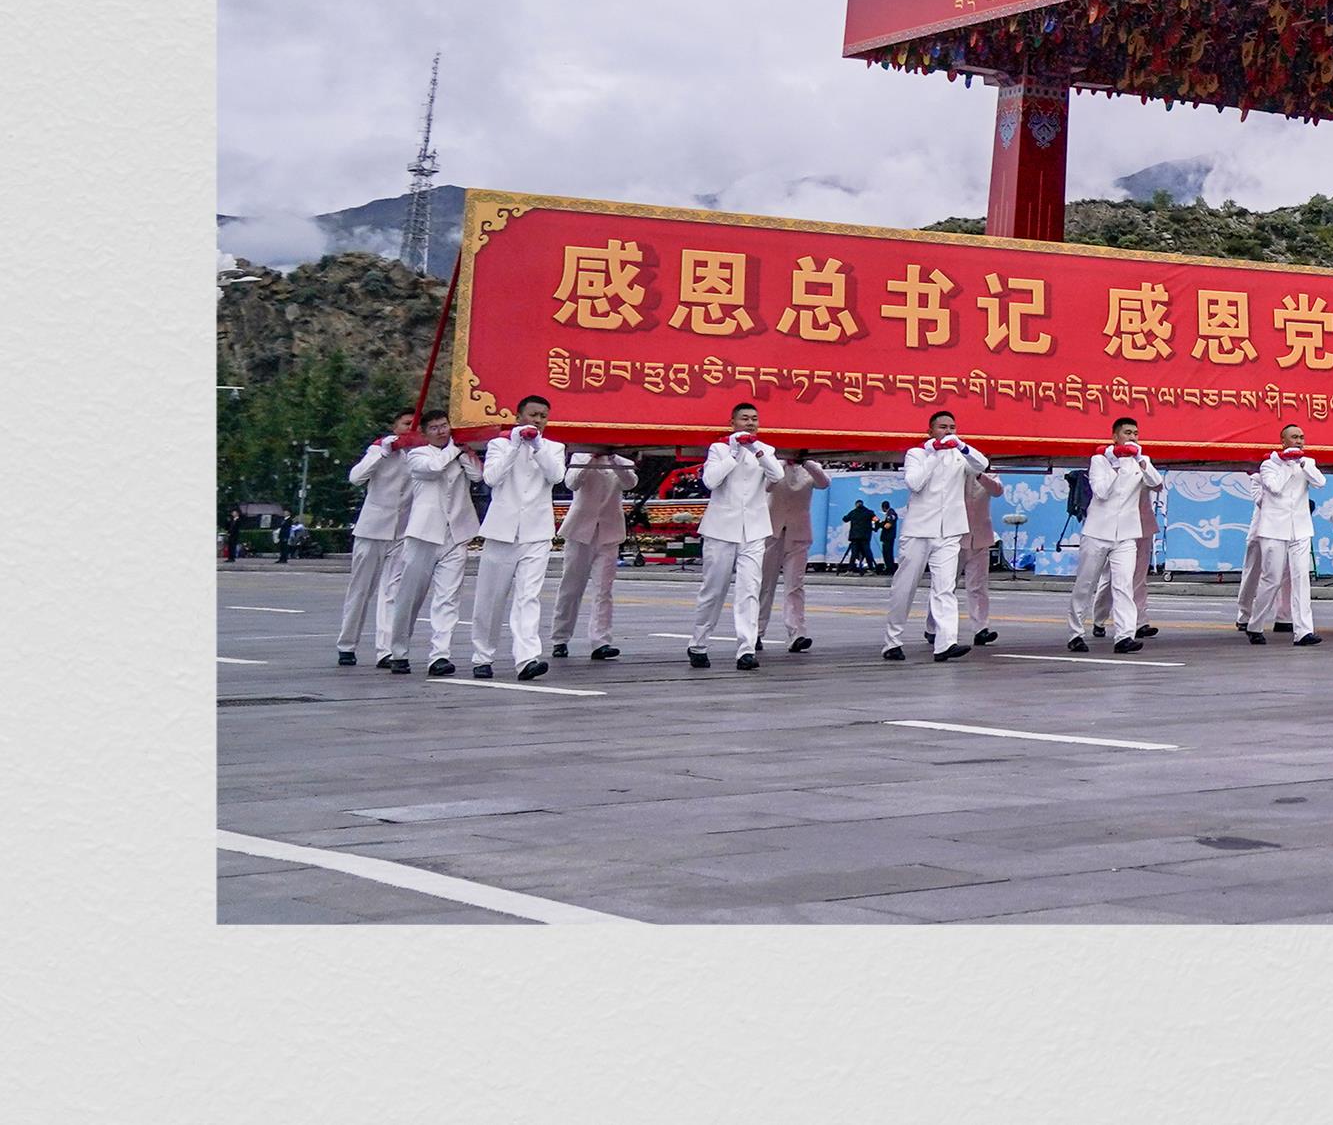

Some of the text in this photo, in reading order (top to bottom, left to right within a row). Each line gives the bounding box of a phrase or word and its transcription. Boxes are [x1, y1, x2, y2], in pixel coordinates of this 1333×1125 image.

[552, 238, 1054, 355] 感恩总书记
